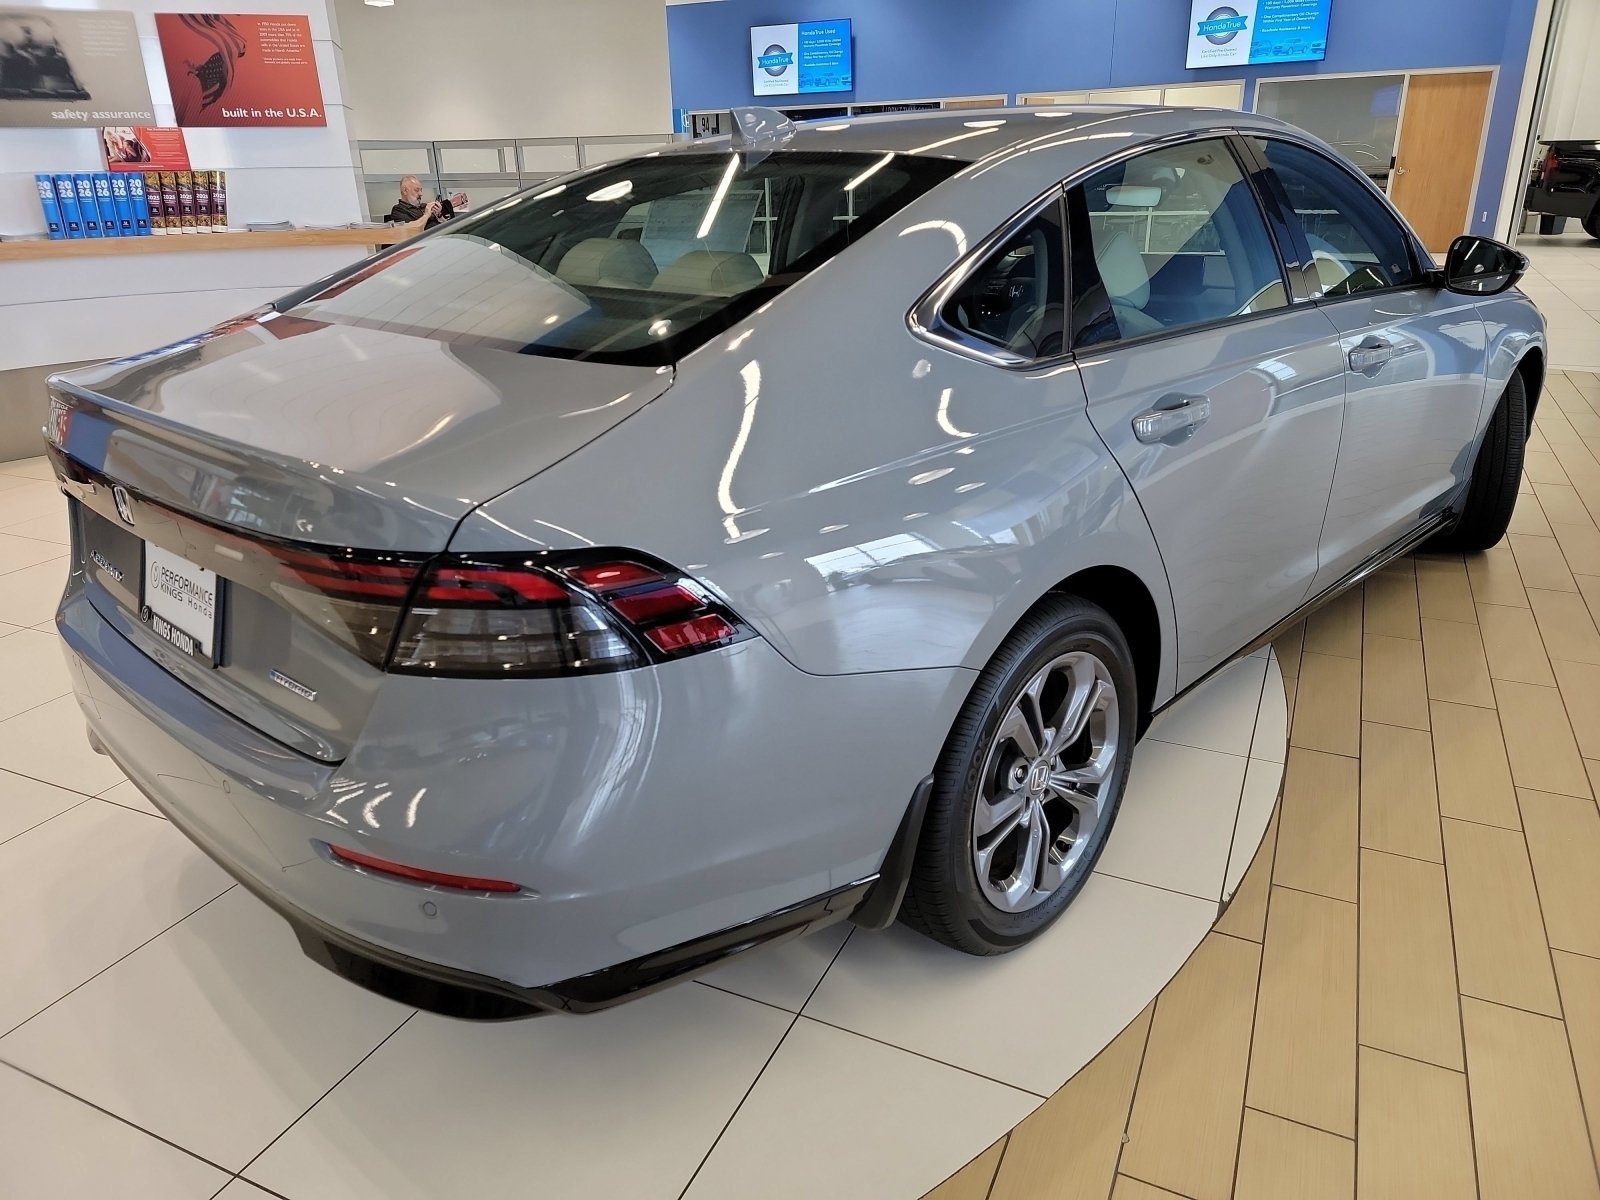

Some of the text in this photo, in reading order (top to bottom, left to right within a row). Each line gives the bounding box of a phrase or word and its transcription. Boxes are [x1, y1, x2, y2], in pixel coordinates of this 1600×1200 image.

[1203, 21, 1241, 32] HondaTrue
[51, 108, 151, 122] safety assurance
[222, 107, 322, 118] built in the U.S.A.
[40, 190, 53, 199] 26
[60, 189, 74, 198] 26
[78, 189, 92, 197] 26
[97, 188, 110, 197] 26
[113, 188, 127, 196] 26
[130, 187, 143, 196] 26
[160, 566, 213, 607] PERFORMANCE
[160, 582, 212, 620] KINGS Honda
[153, 614, 194, 657] KINGS HONDA
[276, 674, 312, 699] HYBRID
